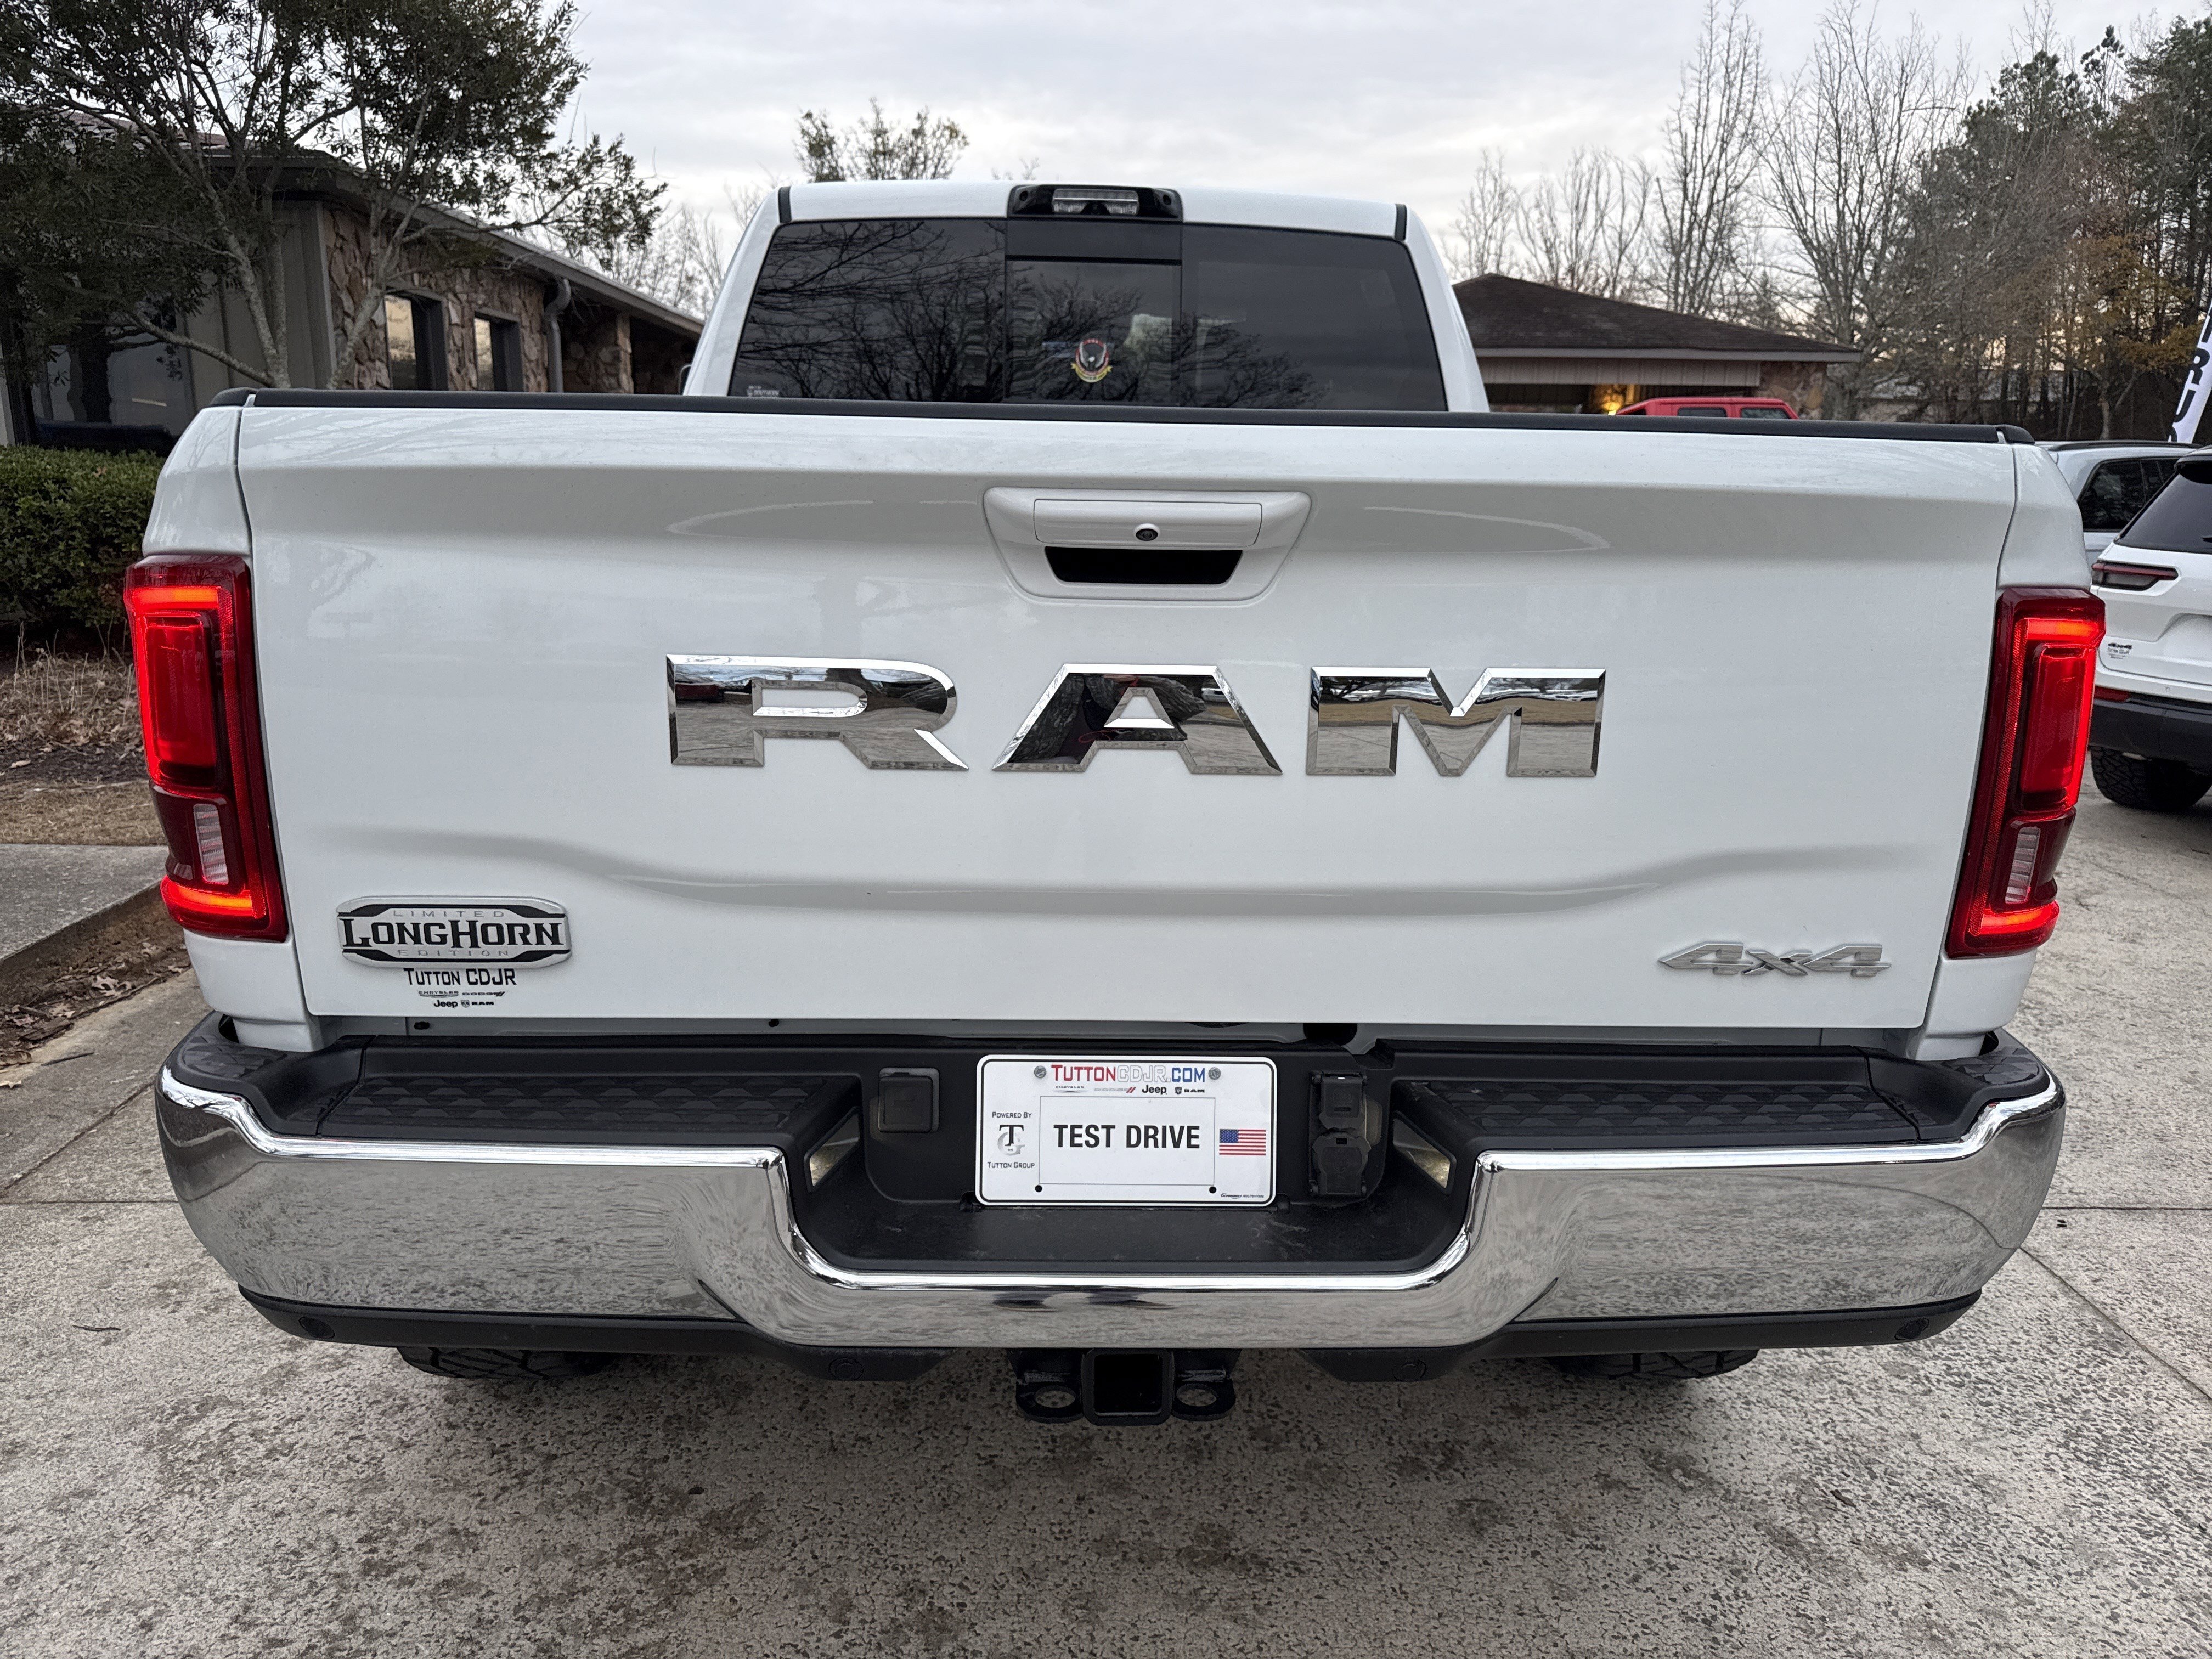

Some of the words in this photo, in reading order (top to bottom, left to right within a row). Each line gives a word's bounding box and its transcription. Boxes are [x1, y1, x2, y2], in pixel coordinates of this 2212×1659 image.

[664, 653, 1607, 777] RAM
[393, 910, 505, 918] LIMITED
[339, 918, 565, 949] LONGHORN
[1658, 941, 1892, 977] 4x4
[403, 968, 461, 985] TUTTON
[466, 968, 517, 985] CDJR
[433, 999, 458, 1008] Jeep
[1142, 1084, 1167, 1095] Jeep
[1053, 1124, 1116, 1148] TEST
[1126, 1125, 1200, 1149] DRIVE
